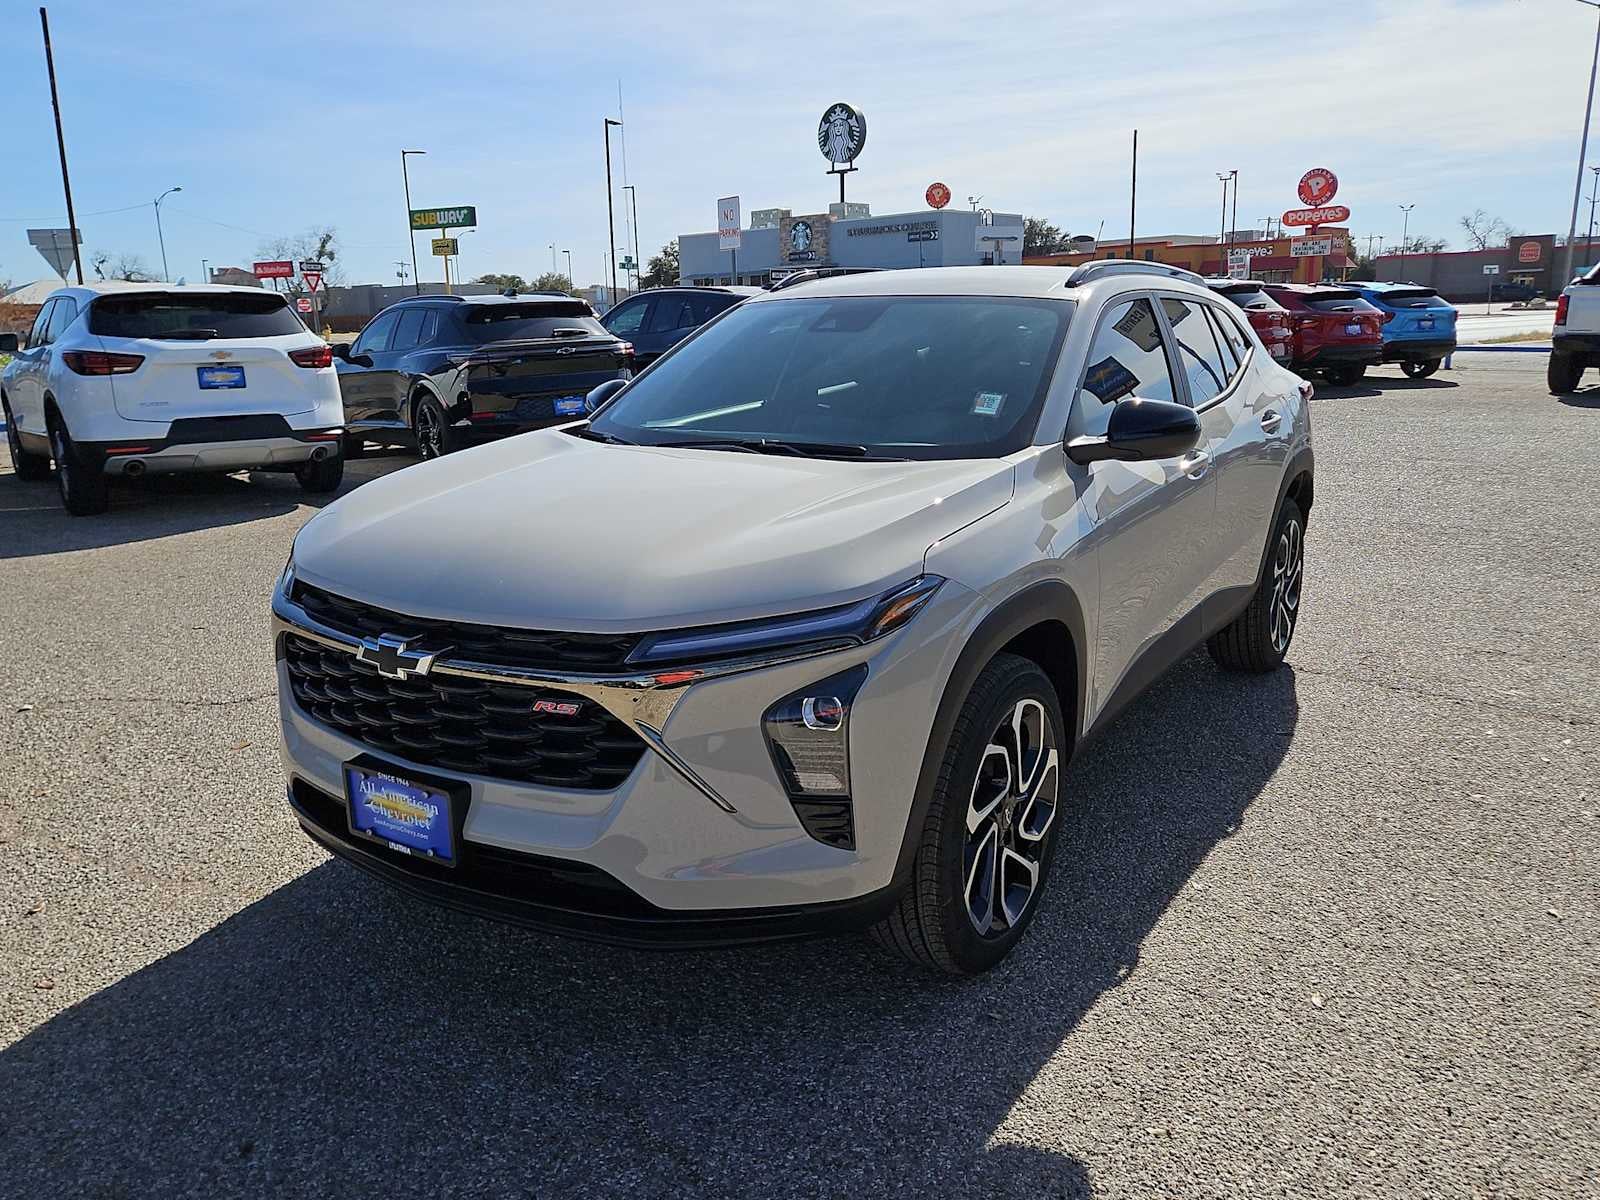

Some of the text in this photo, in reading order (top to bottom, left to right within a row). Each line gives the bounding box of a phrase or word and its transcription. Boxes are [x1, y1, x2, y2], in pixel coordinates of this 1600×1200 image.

[1308, 177, 1327, 197] P
[413, 210, 465, 226] SUBWAY
[723, 208, 735, 222] NO
[719, 228, 742, 239] PARKING
[533, 701, 579, 715] RS
[377, 772, 396, 784] SINCE
[359, 780, 439, 816] All American
[370, 800, 432, 830] Chevrolet
